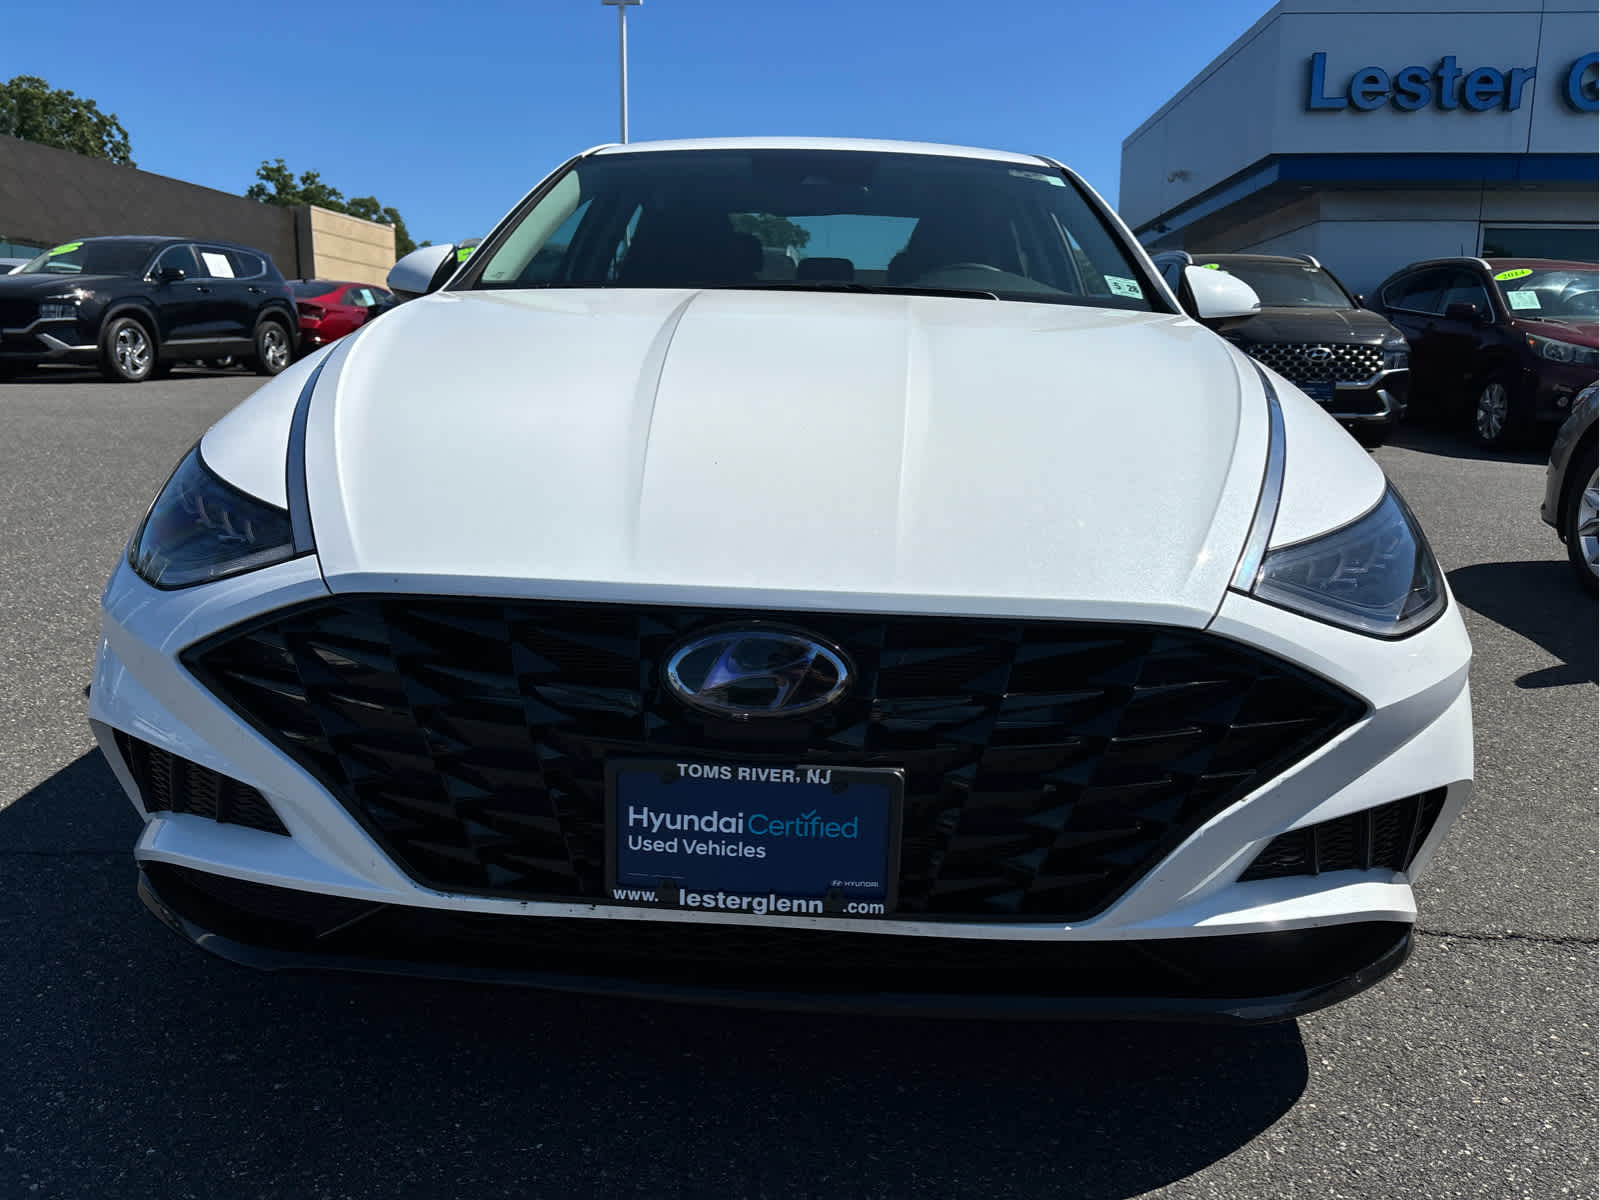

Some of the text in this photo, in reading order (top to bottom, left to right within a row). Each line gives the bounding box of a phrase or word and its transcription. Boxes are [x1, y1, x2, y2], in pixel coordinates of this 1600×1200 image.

[1305, 51, 1537, 112] Lester
[677, 763, 832, 785] TOMS RIVER, NJ
[628, 806, 858, 839] Hyundai Certified
[628, 835, 766, 859] Used Vehicles
[613, 888, 884, 915] www. lesterglenn .com
